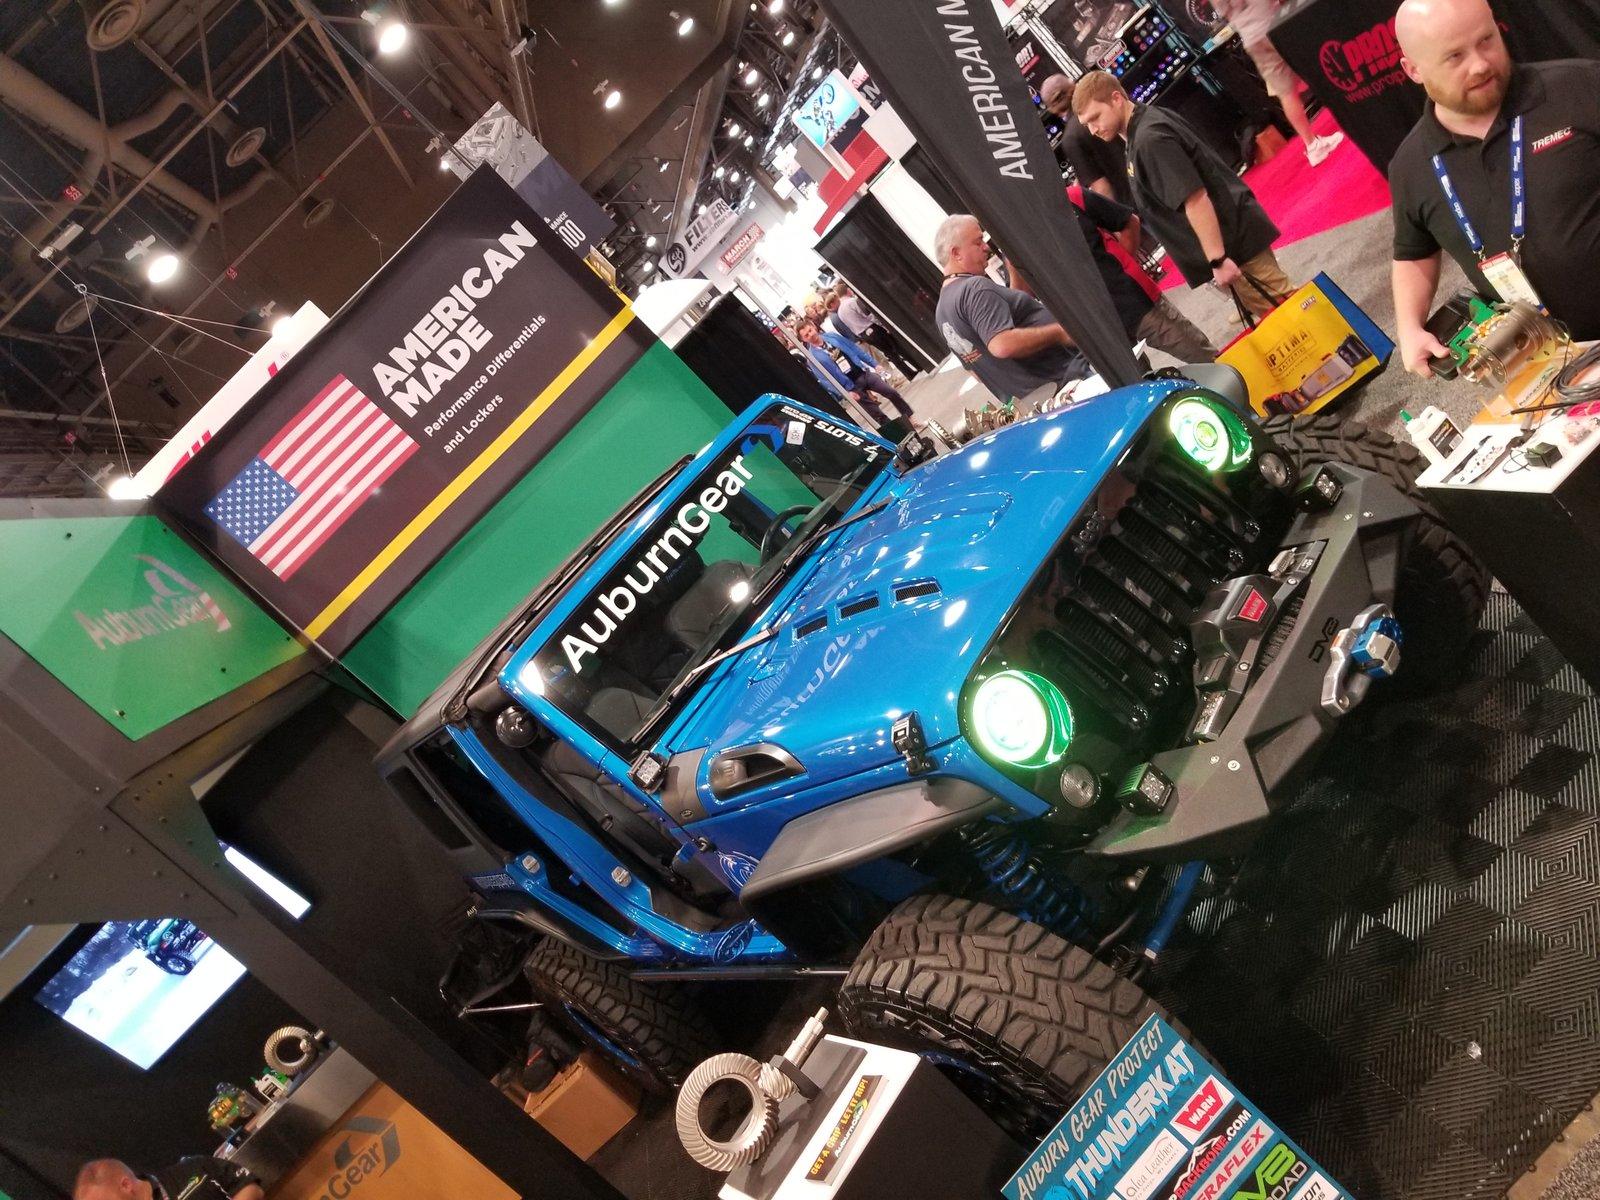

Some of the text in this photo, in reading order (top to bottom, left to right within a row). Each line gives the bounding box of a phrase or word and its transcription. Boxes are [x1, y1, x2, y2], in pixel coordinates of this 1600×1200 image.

[944, 23, 1034, 180] AMERICAN
[1532, 126, 1572, 151] TREMEC
[684, 200, 729, 247] FILTERS
[724, 233, 752, 262] MARCH
[372, 220, 538, 397] AMERICAN
[390, 315, 494, 418] MADE
[424, 314, 546, 437] Performance Differentials
[443, 394, 504, 454] and Lockers
[813, 420, 865, 447] SLOTS
[560, 454, 753, 674] AuburnGear
[1016, 1128, 1070, 1200] AUBURN
[1070, 1088, 1108, 1143] GEAR
[1107, 1018, 1164, 1099] PROJECT
[1064, 1039, 1195, 1200] THUNDERKAT
[1188, 1095, 1216, 1126] WARN
[1145, 1142, 1174, 1175] Leather
